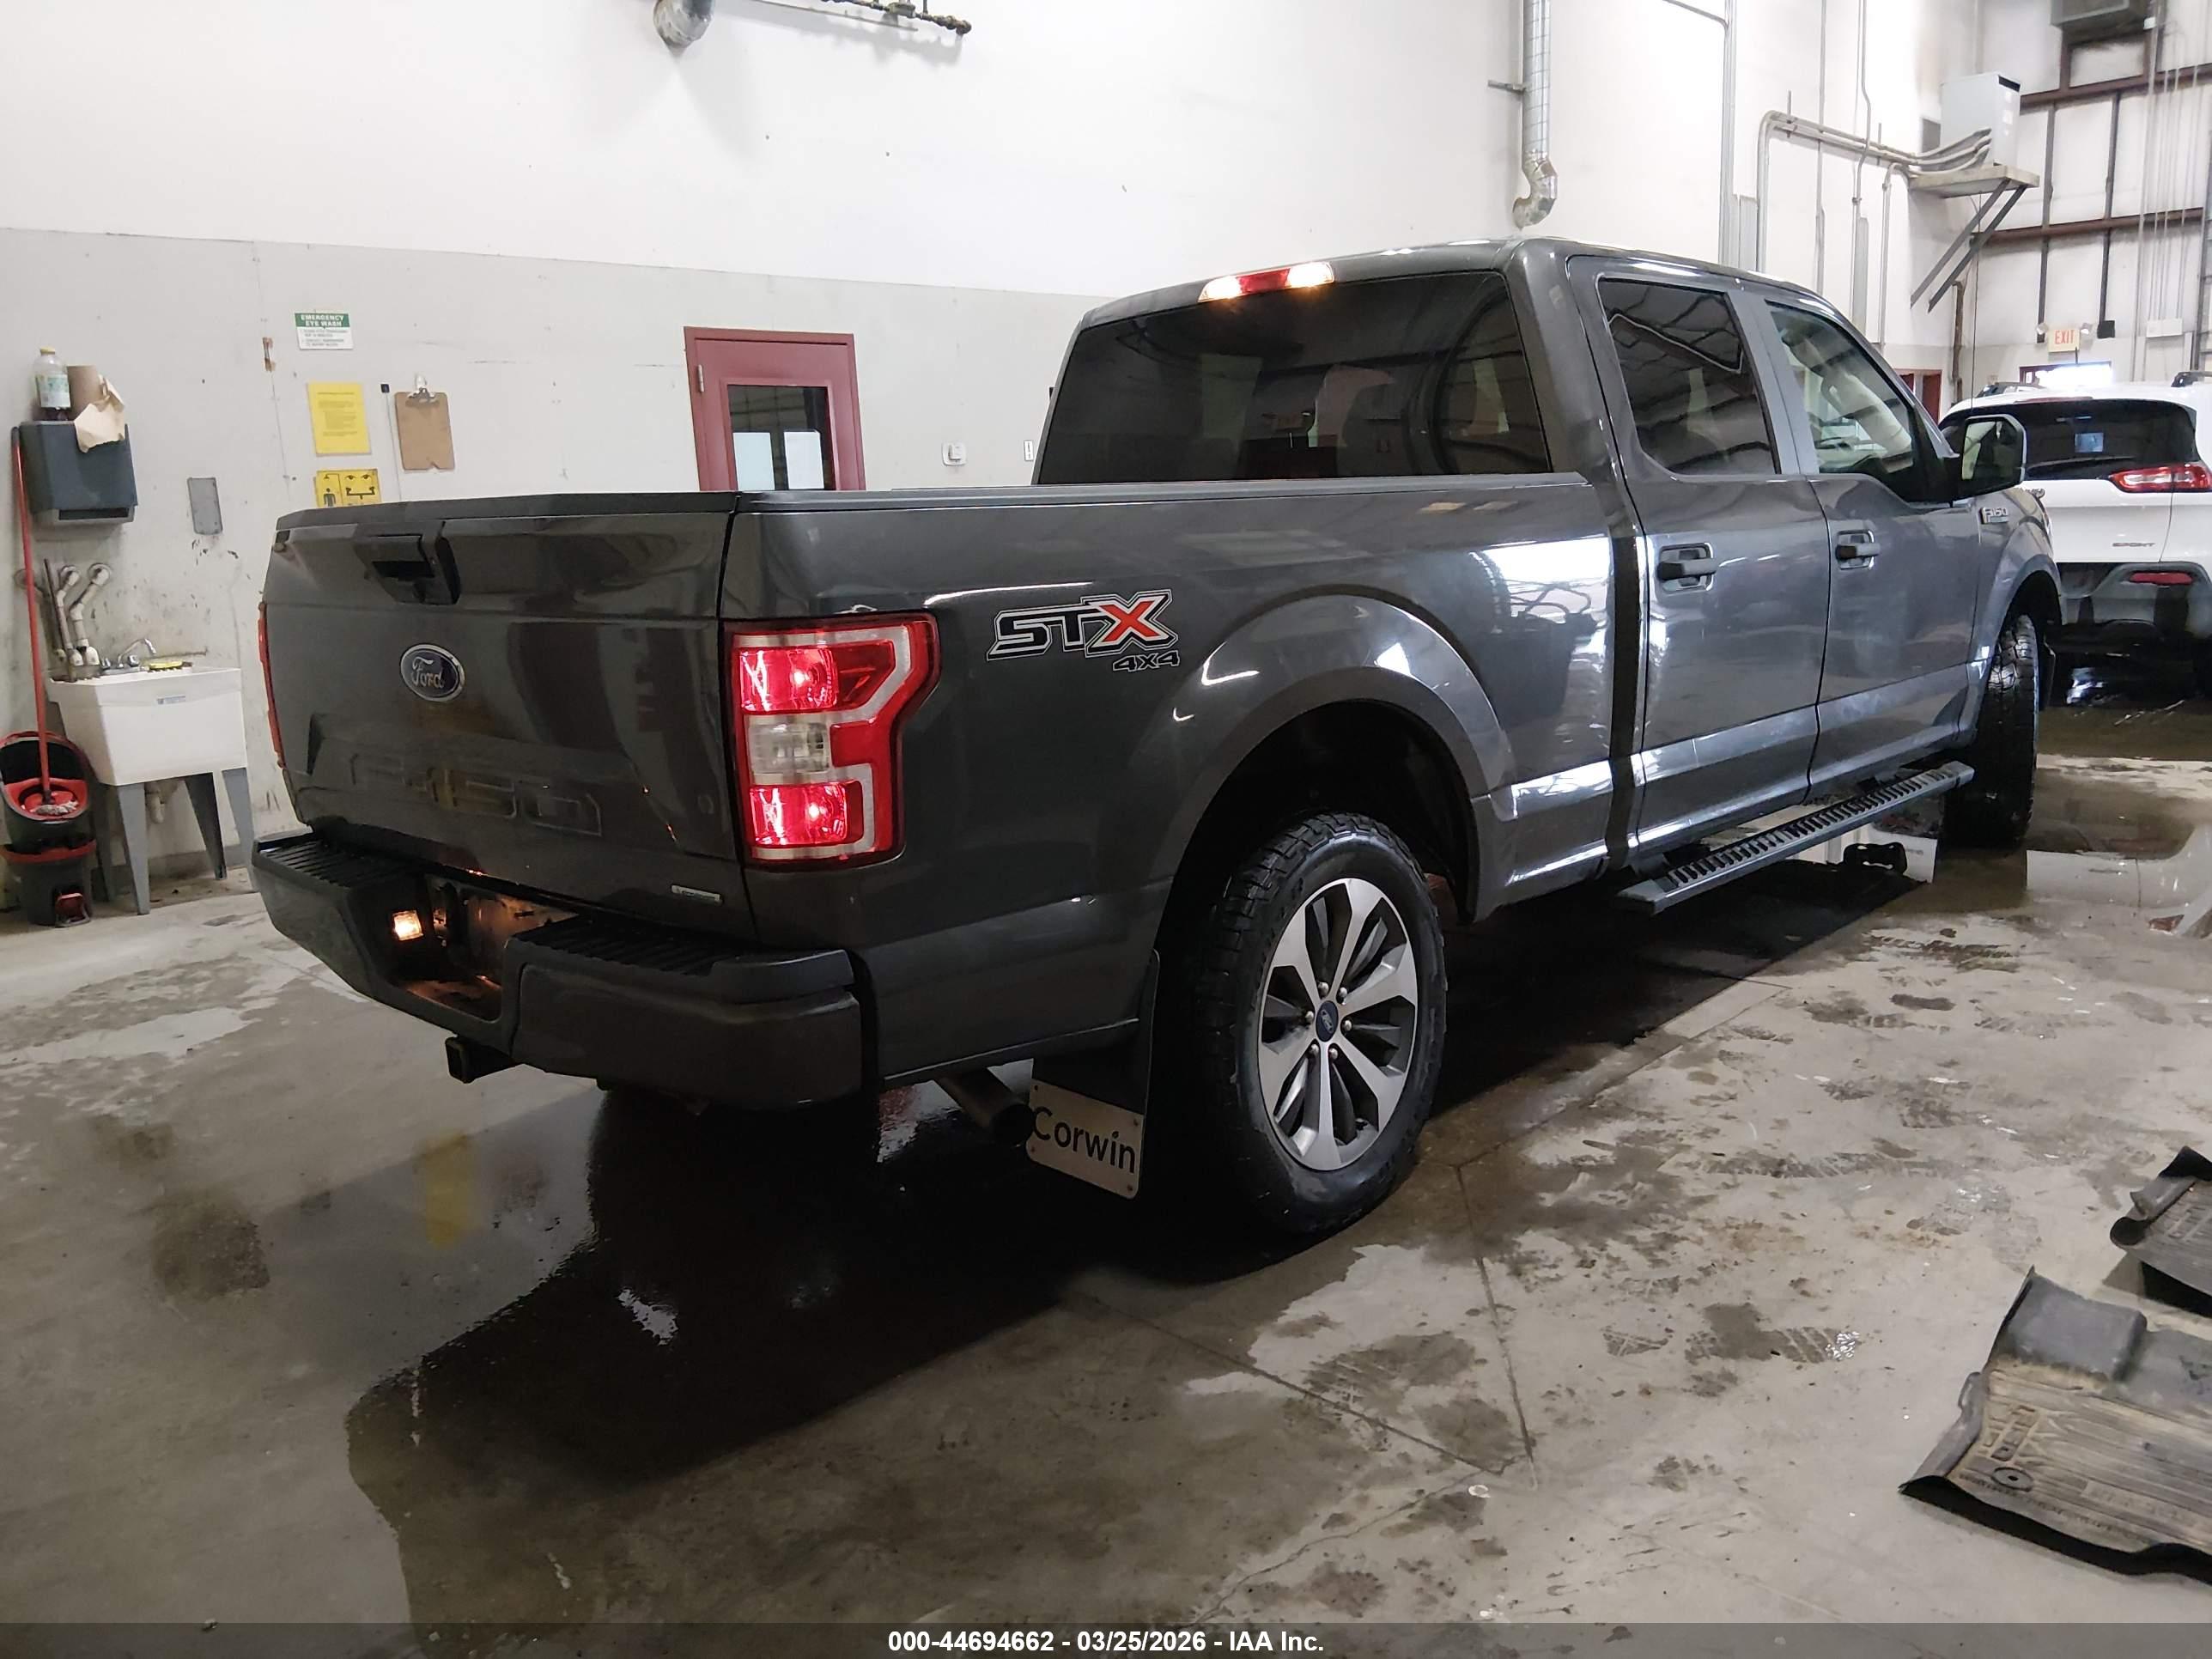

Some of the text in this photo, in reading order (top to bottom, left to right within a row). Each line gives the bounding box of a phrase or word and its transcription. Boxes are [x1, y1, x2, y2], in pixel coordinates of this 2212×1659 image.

[2055, 329, 2075, 344] EXIT
[988, 590, 1179, 660] STX
[411, 655, 446, 689] Ford
[1033, 1106, 1135, 1173] Corwin
